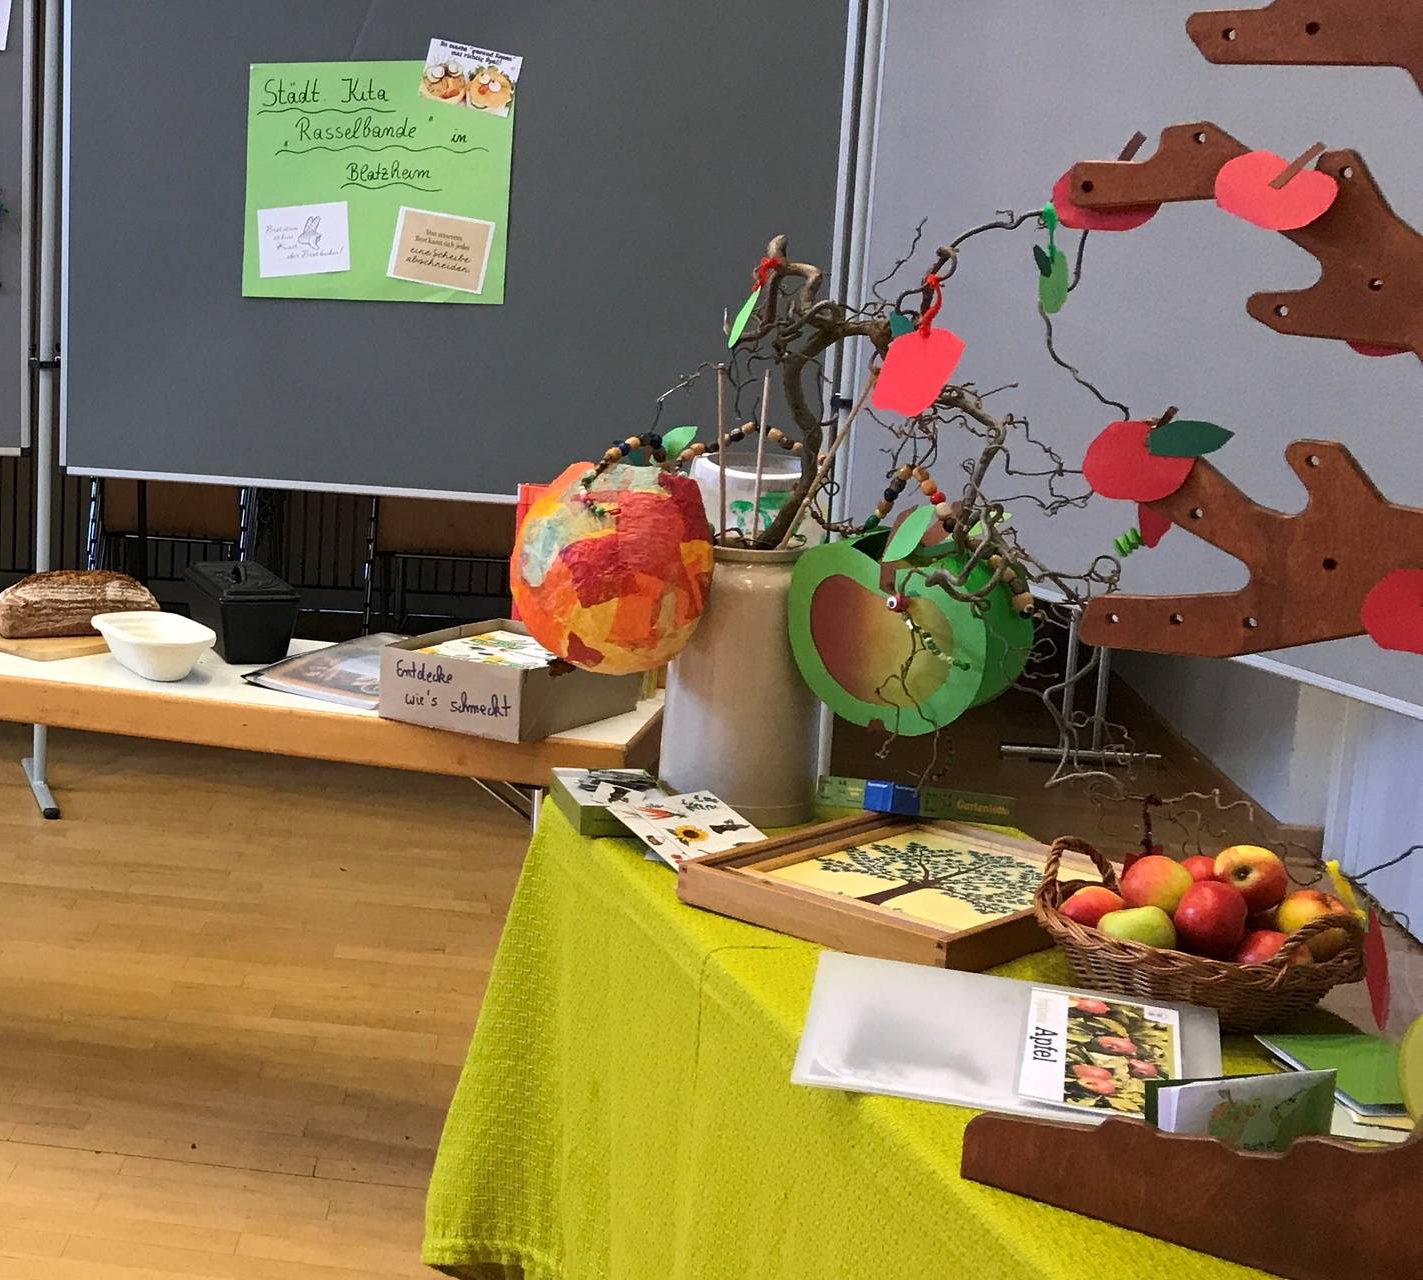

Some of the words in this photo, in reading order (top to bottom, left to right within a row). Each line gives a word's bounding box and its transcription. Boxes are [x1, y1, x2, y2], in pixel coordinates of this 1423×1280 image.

[340, 78, 390, 104] Kita
[450, 128, 468, 144] in
[345, 159, 433, 182] Blatzheim
[395, 659, 453, 685] Entdecke
[405, 690, 438, 708] wie's
[450, 690, 512, 718] schmeckt
[1029, 1026, 1059, 1063] Apfel
